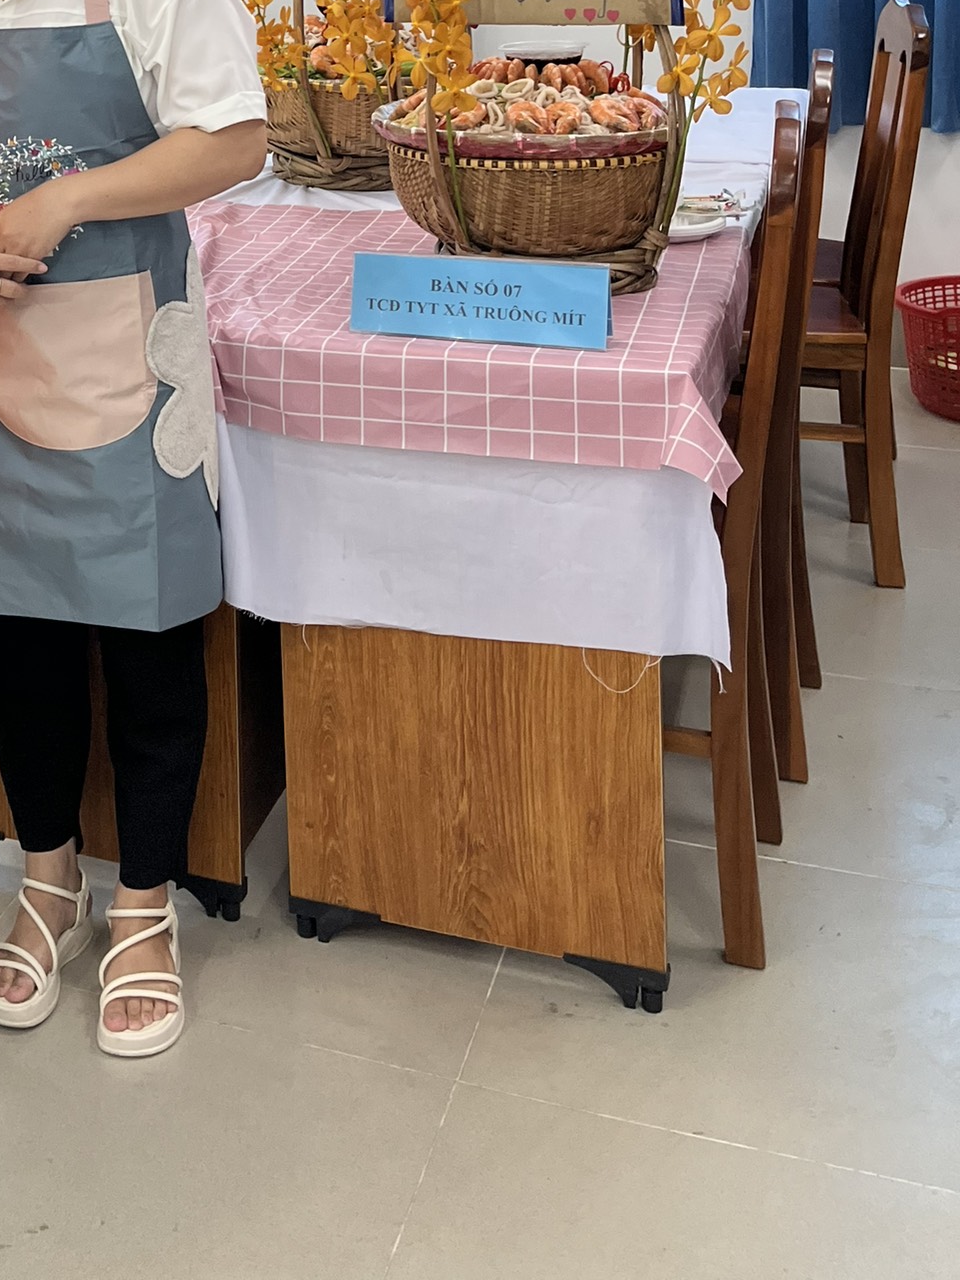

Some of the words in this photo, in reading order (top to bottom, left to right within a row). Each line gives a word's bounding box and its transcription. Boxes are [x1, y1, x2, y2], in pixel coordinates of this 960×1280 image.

[430, 276, 469, 294] BÀN
[503, 283, 522, 298] 07
[366, 298, 401, 312] TCĐ
[404, 300, 440, 315] TYT
[443, 301, 468, 317] XÃ
[472, 305, 548, 324] TRUÔNG
[552, 309, 587, 326] MÍT
